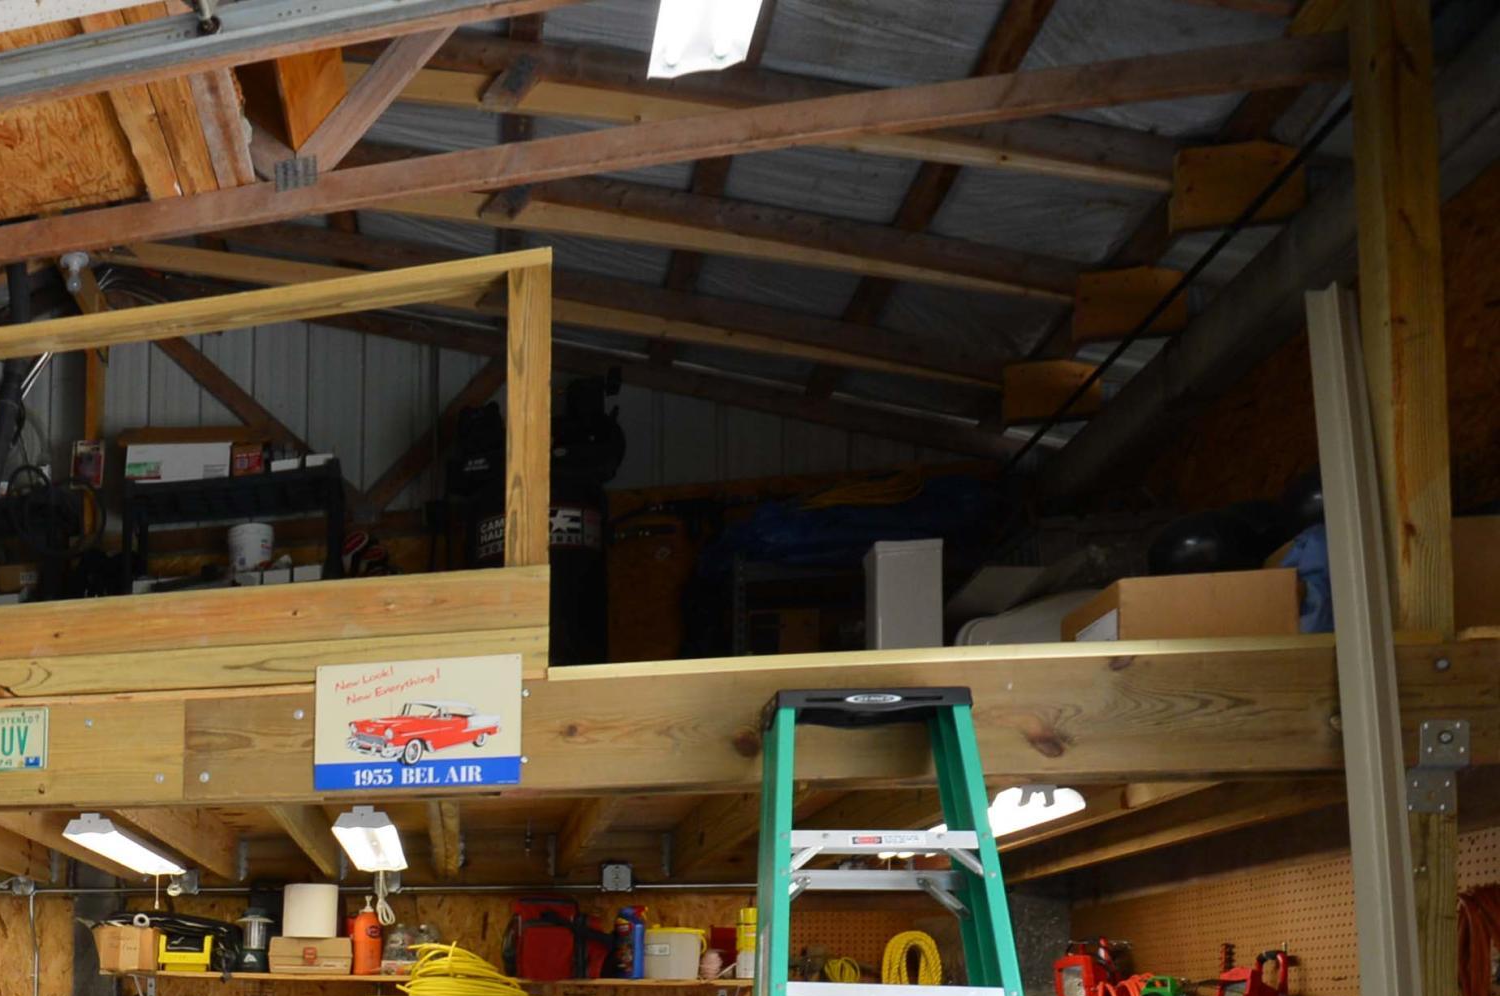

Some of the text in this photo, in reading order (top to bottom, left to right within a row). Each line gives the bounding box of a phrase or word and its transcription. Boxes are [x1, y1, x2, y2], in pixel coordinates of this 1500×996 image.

[374, 667, 441, 697] Everything!
[1, 725, 29, 757] UV
[353, 765, 483, 787] 1955 BEL AIR
